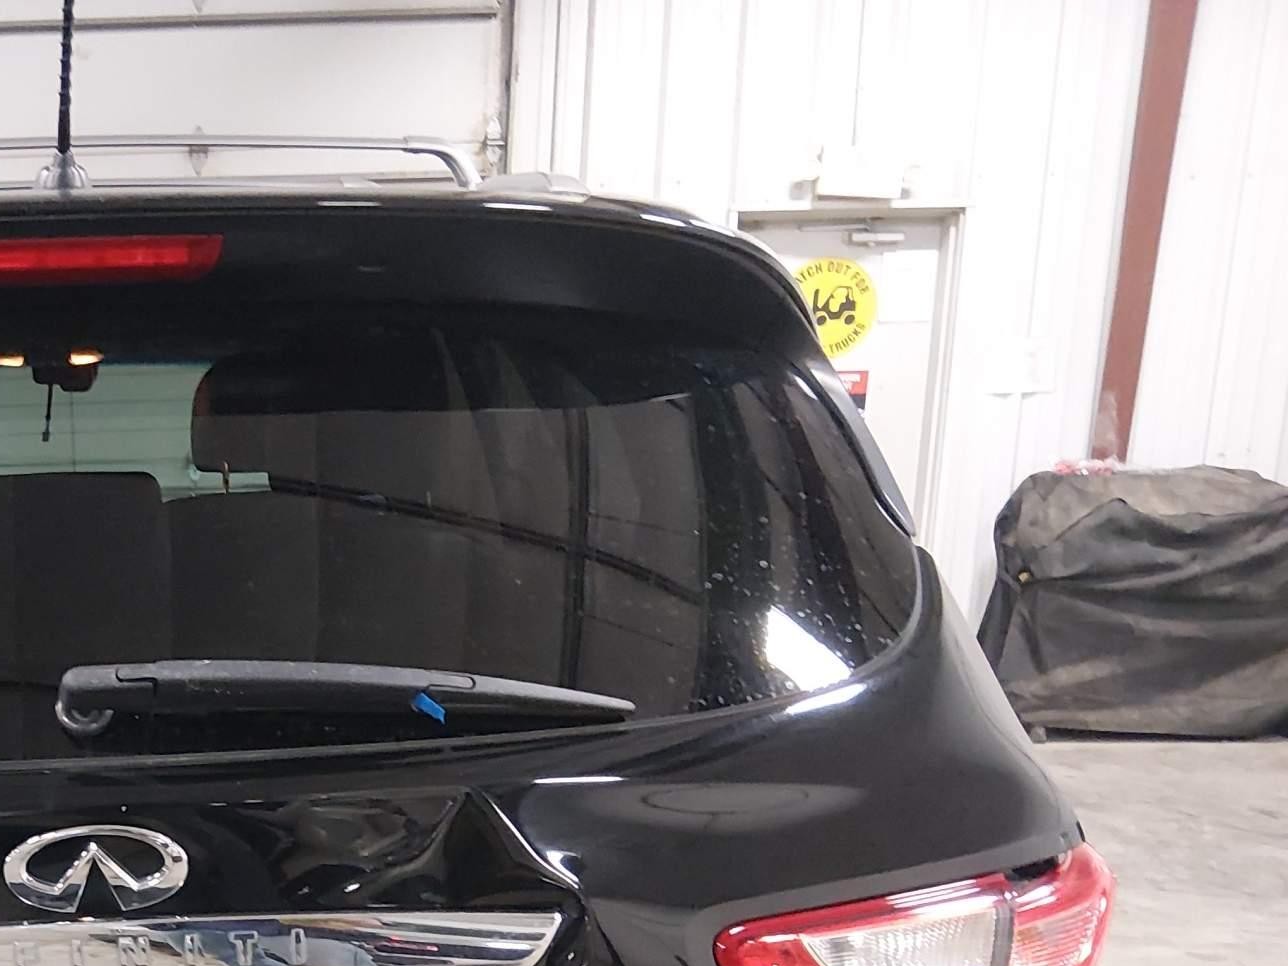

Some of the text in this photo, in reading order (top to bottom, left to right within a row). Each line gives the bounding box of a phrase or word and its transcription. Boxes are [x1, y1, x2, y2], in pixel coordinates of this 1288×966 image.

[827, 261, 852, 275] OUT
[851, 271, 870, 294] FOR
[829, 322, 866, 354] TRUCKS
